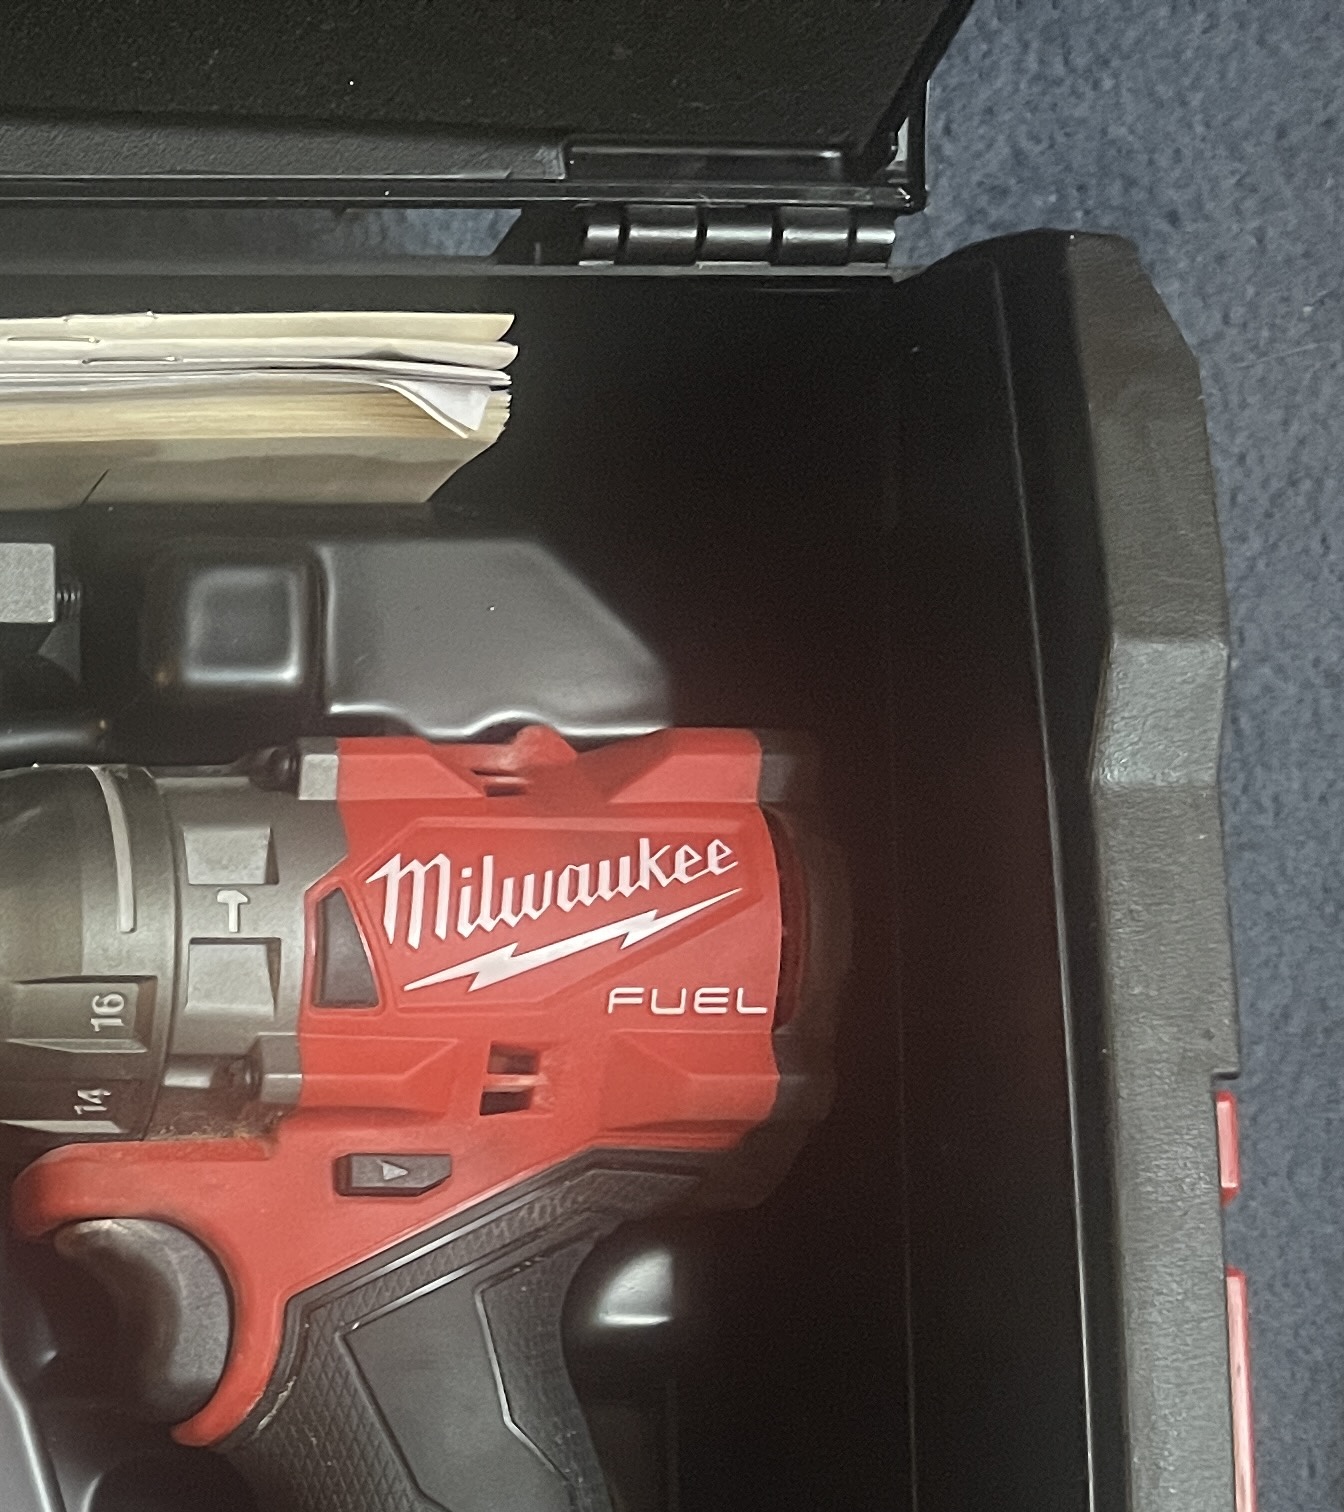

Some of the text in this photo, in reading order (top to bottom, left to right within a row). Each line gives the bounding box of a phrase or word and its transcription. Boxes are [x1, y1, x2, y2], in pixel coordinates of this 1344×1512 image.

[365, 837, 739, 950] Milwaukee
[90, 993, 126, 1032] 16
[607, 986, 768, 1015] FUEL
[73, 1088, 112, 1115] 14
